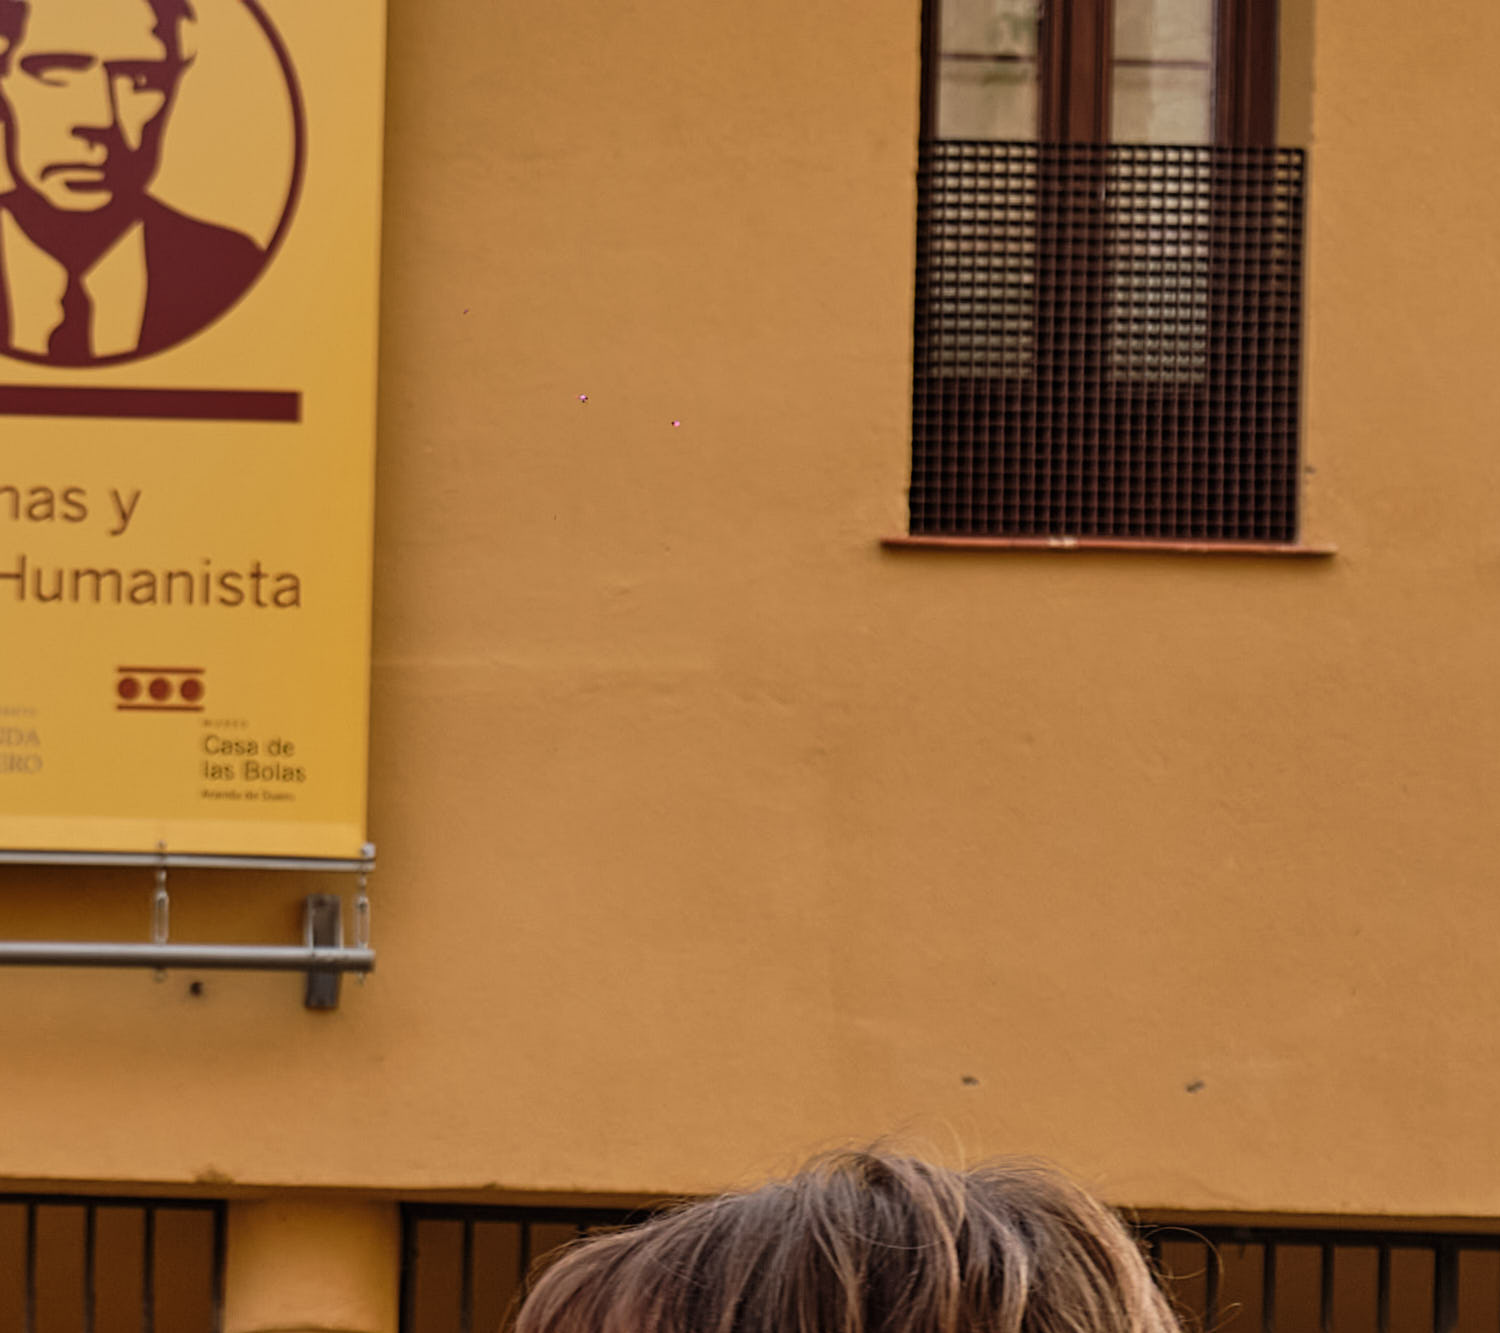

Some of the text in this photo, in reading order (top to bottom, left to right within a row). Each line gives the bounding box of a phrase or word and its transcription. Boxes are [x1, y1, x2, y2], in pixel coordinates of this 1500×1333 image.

[108, 488, 142, 537] y
[204, 734, 295, 757] Casa de
[204, 760, 307, 783] las Bolas
